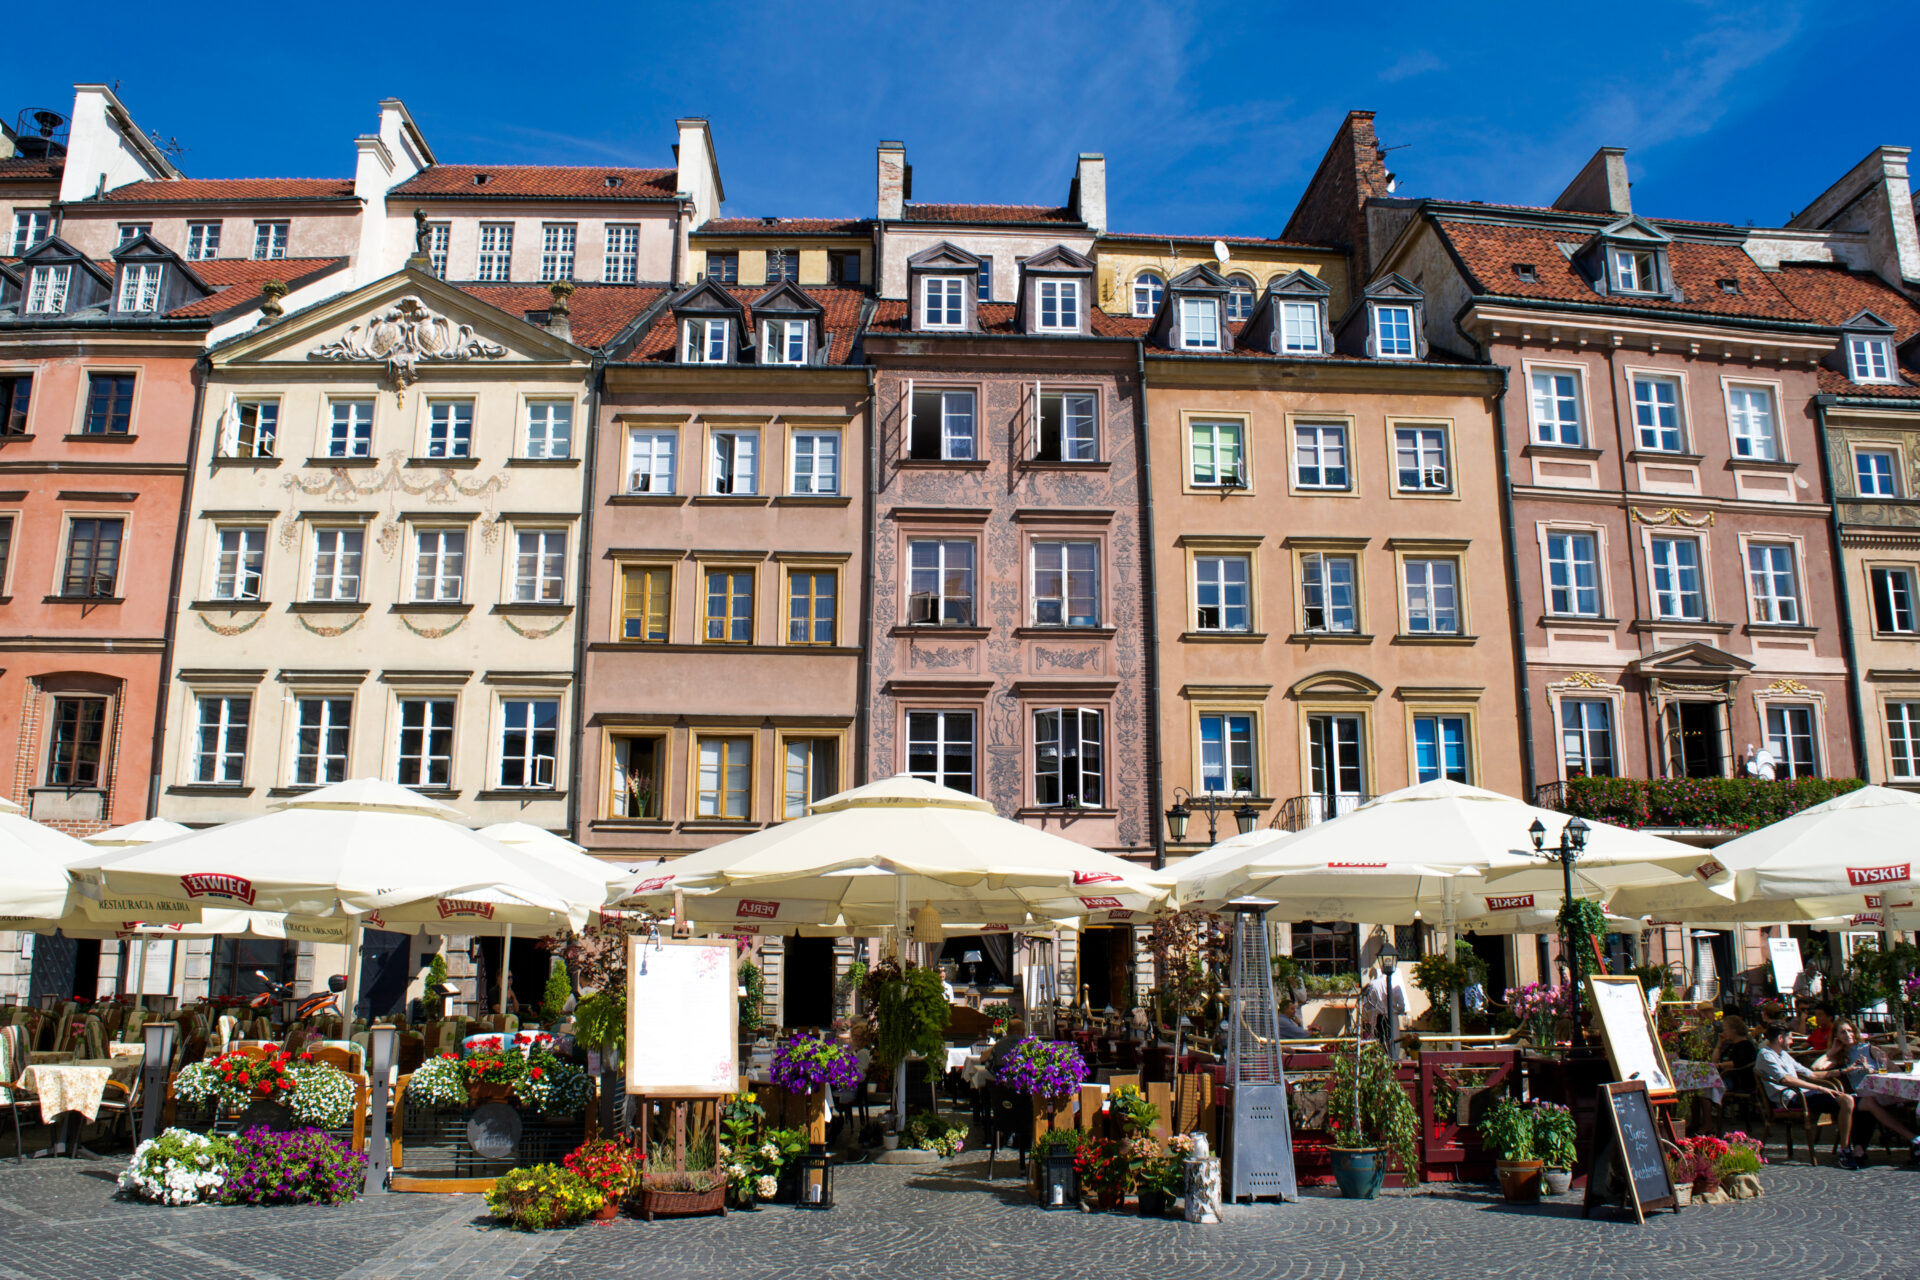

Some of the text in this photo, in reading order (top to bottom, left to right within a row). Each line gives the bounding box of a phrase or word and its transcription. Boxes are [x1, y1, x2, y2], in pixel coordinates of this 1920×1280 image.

[1850, 865, 1907, 883] TYSKIE
[188, 874, 246, 896] ŻYWIEC
[156, 901, 191, 912] ARKADIA
